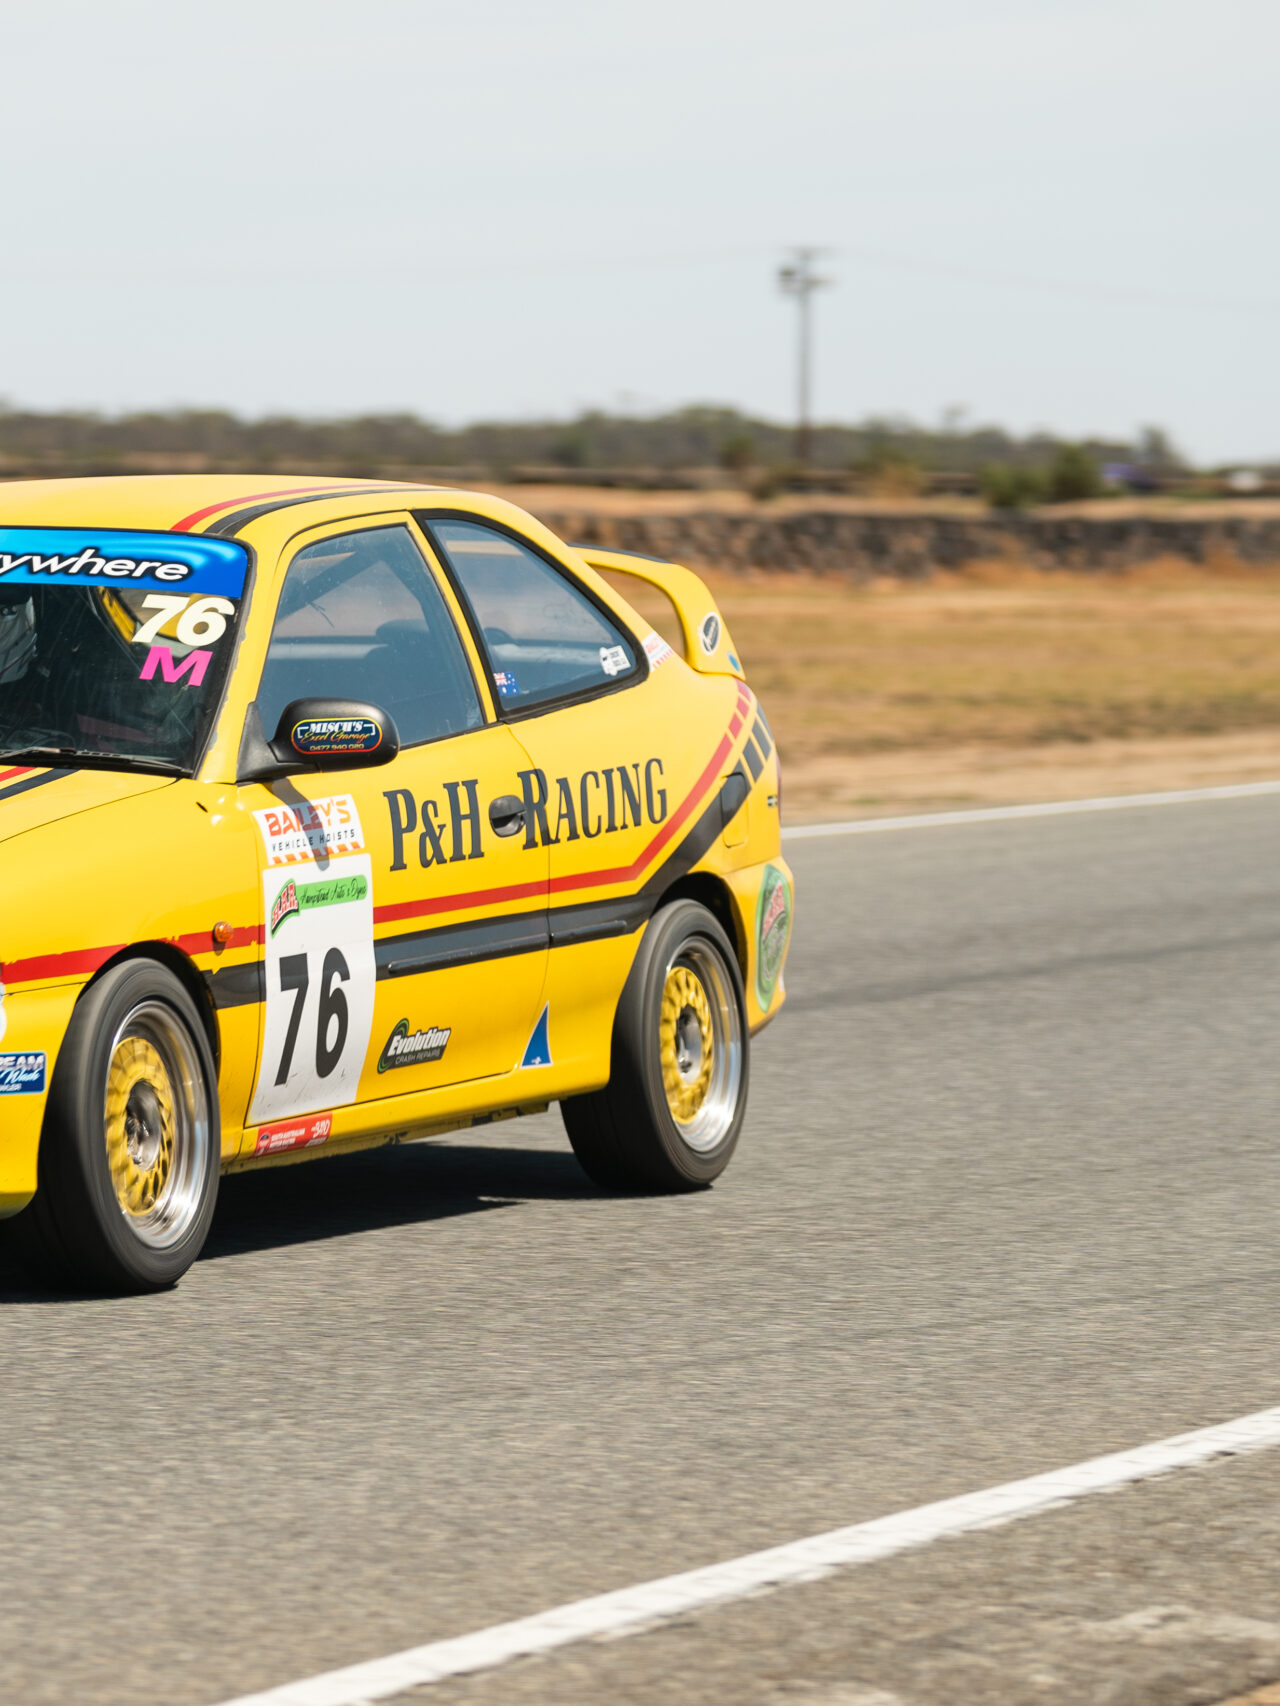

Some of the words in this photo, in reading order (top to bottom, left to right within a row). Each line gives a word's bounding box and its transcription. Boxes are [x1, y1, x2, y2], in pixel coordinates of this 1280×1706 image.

[131, 594, 236, 647] 76
[139, 645, 213, 687] M
[300, 731, 330, 744] Excel
[330, 731, 371, 744] Garage
[309, 721, 364, 734] MISCH'S
[264, 798, 351, 837] BAILEY'S
[382, 779, 485, 872] P&H
[517, 758, 668, 851] RACING
[272, 836, 314, 853] VEHICLE
[320, 828, 356, 844] HOISTS
[274, 947, 351, 1087] 76
[387, 1027, 451, 1057] Evolution
[395, 1054, 416, 1065] CRASH
[416, 1048, 440, 1060] REPAIRS
[0, 1067, 41, 1085] Wash
